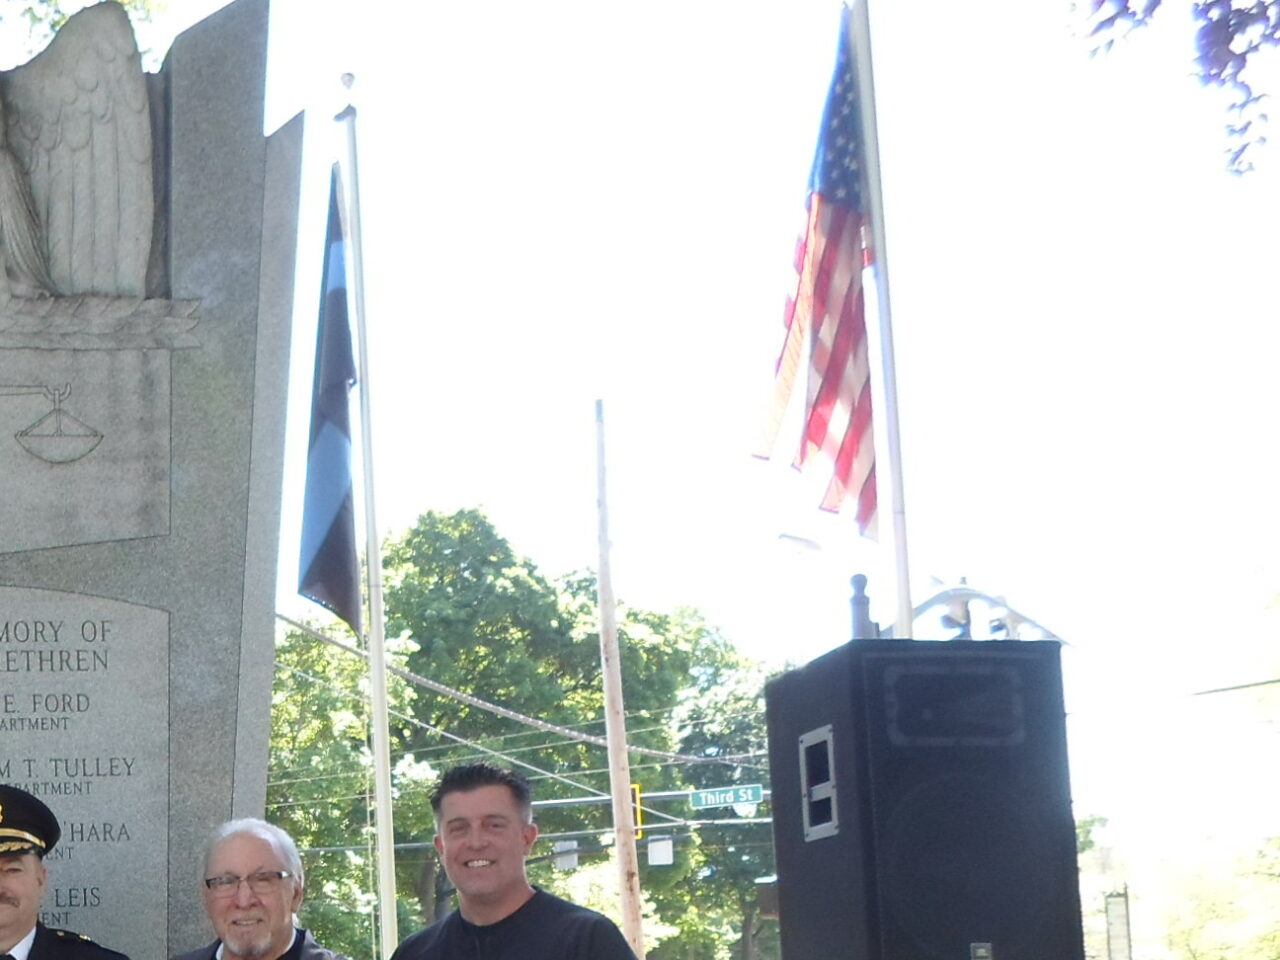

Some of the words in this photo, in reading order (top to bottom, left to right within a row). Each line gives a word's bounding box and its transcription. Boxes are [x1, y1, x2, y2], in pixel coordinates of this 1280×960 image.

[81, 619, 113, 642] OF
[4, 695, 20, 714] E.
[33, 694, 90, 713] FORD
[24, 759, 39, 779] T.
[50, 757, 136, 777] TULLEY
[699, 790, 734, 805] Third
[738, 788, 752, 801] St
[63, 821, 131, 842] 'HARA
[55, 887, 101, 908] LEIS
